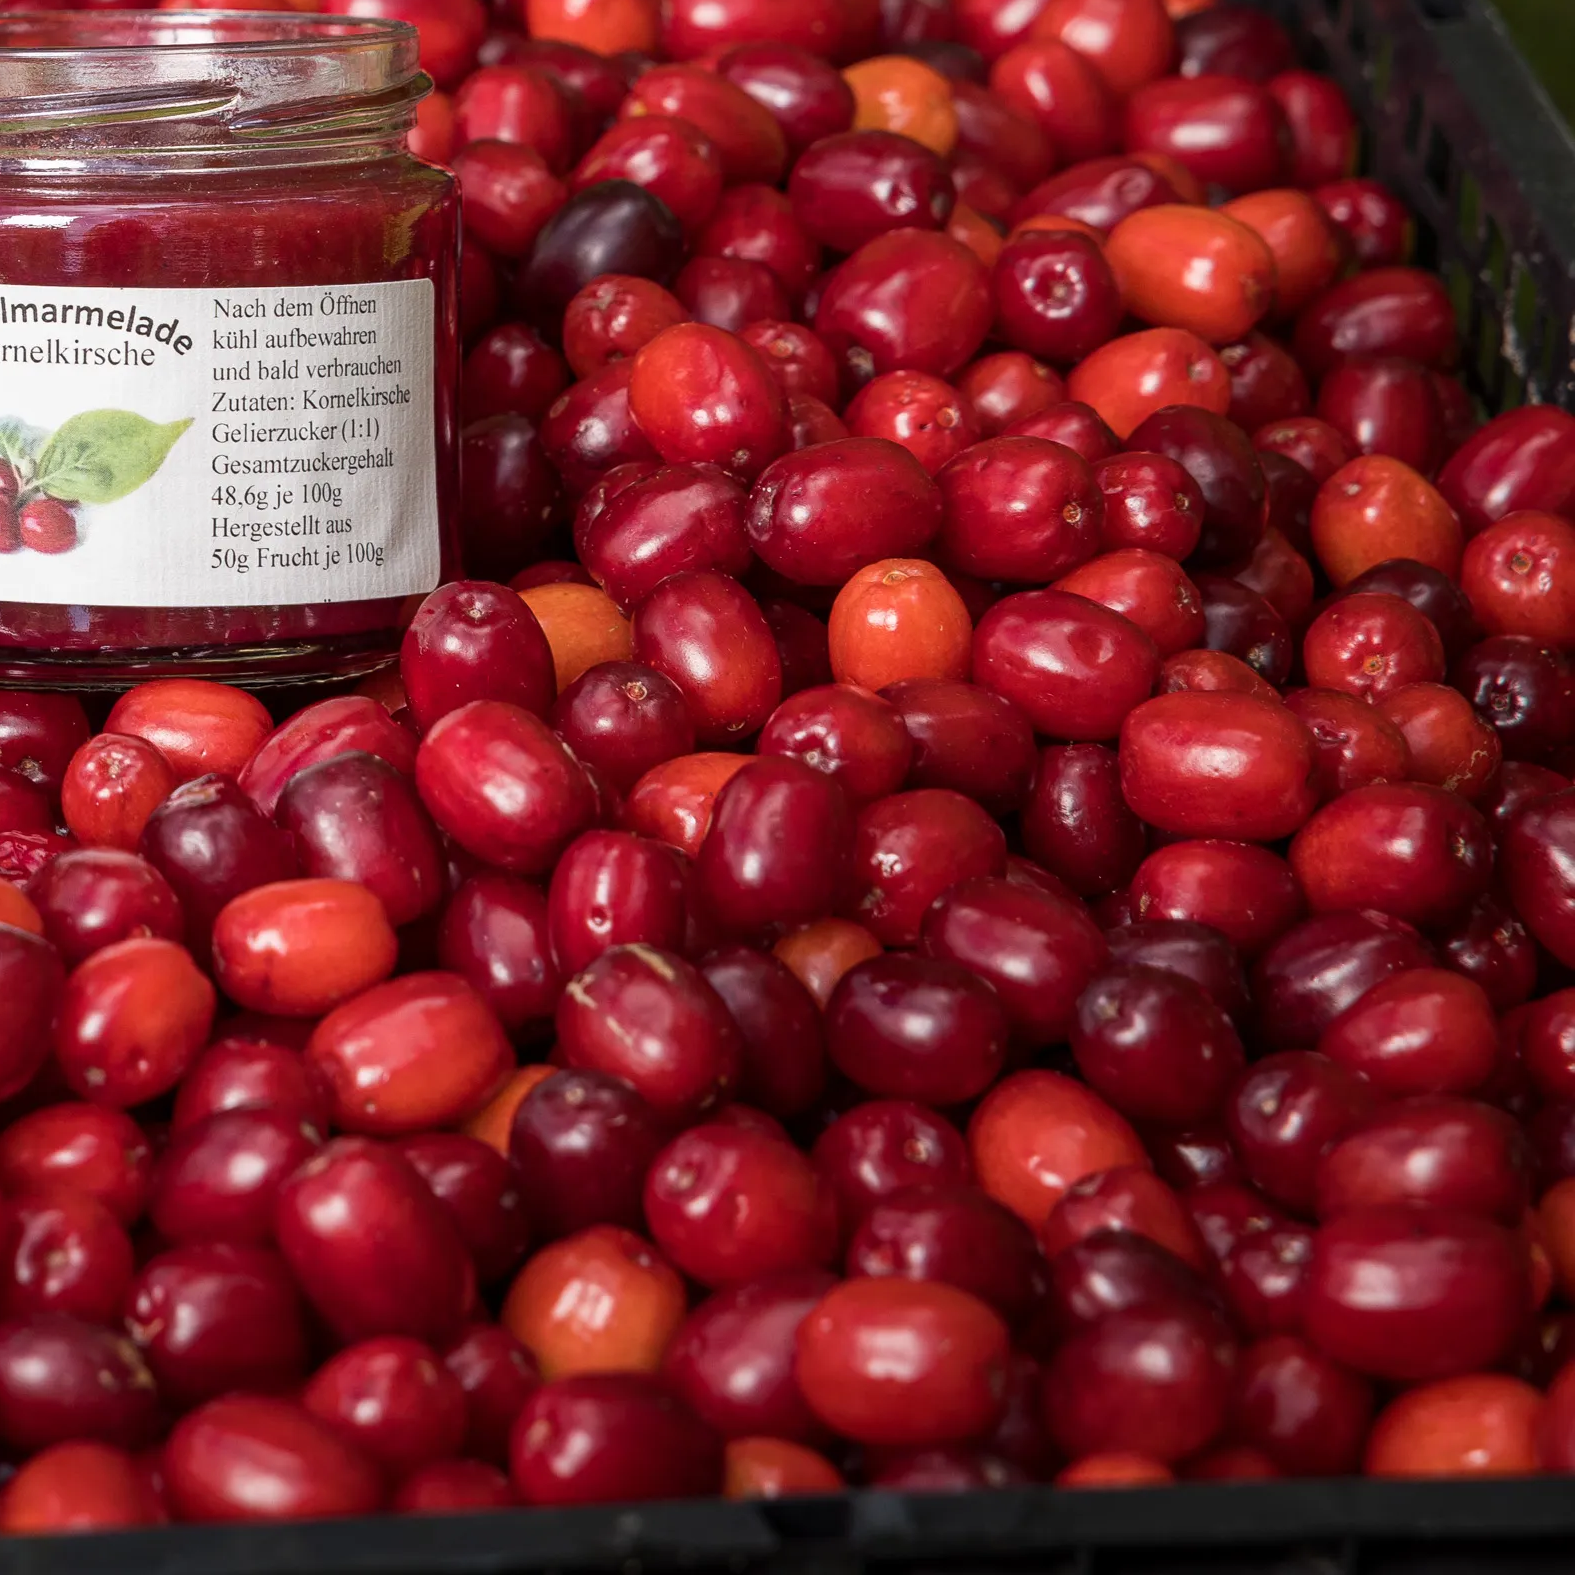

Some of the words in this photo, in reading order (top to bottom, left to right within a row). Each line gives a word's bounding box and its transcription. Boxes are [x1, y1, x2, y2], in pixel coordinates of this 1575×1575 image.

[213, 299, 266, 319] Nach
[273, 297, 313, 318] dem
[319, 292, 377, 316] Öffnen
[212, 329, 258, 350] kühl
[265, 326, 377, 349] aufbewahren
[212, 361, 251, 382] und
[258, 359, 299, 380] bald
[306, 355, 402, 379] verbrauchen
[211, 391, 296, 414] Zutaten:
[302, 386, 411, 411] Kornelkirsche
[212, 420, 338, 444] Gelierzucker
[341, 417, 381, 443] (1:1)
[211, 448, 394, 476] Gesamtzuckergehalt
[211, 485, 269, 510] 48,6g
[273, 484, 294, 510] je
[301, 482, 343, 507] 100g
[211, 516, 321, 542] Hergestellt
[326, 516, 353, 534] aus
[211, 548, 250, 574] 50g
[256, 546, 320, 569] Frucht
[323, 547, 341, 571] je
[347, 541, 385, 566] 100g
